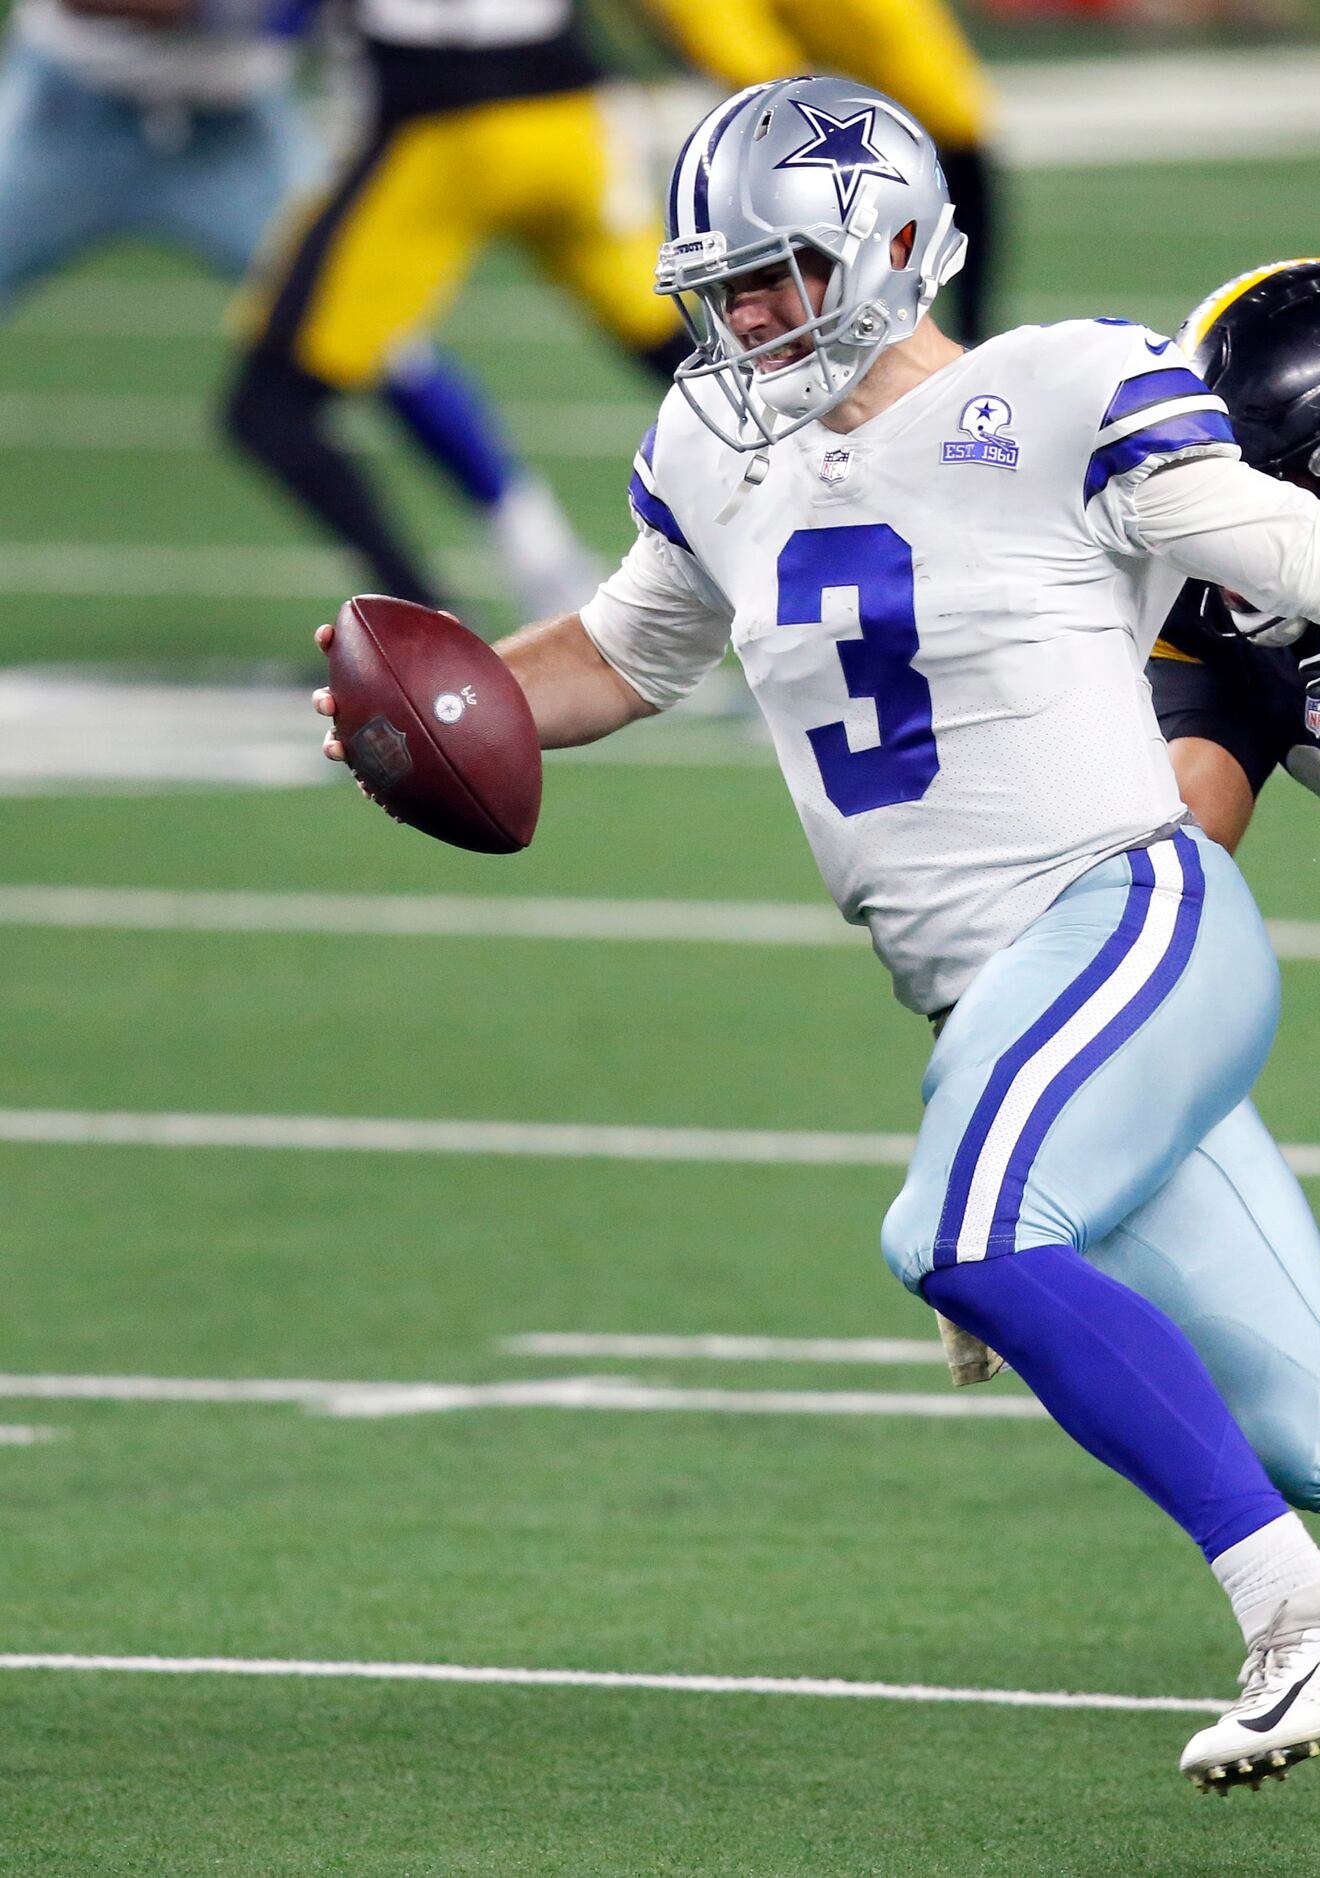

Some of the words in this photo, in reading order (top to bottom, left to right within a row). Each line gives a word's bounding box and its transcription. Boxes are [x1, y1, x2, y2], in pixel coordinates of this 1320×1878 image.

[945, 443, 976, 459] EST.
[981, 445, 1017, 464] 1960
[777, 523, 940, 818] 3
